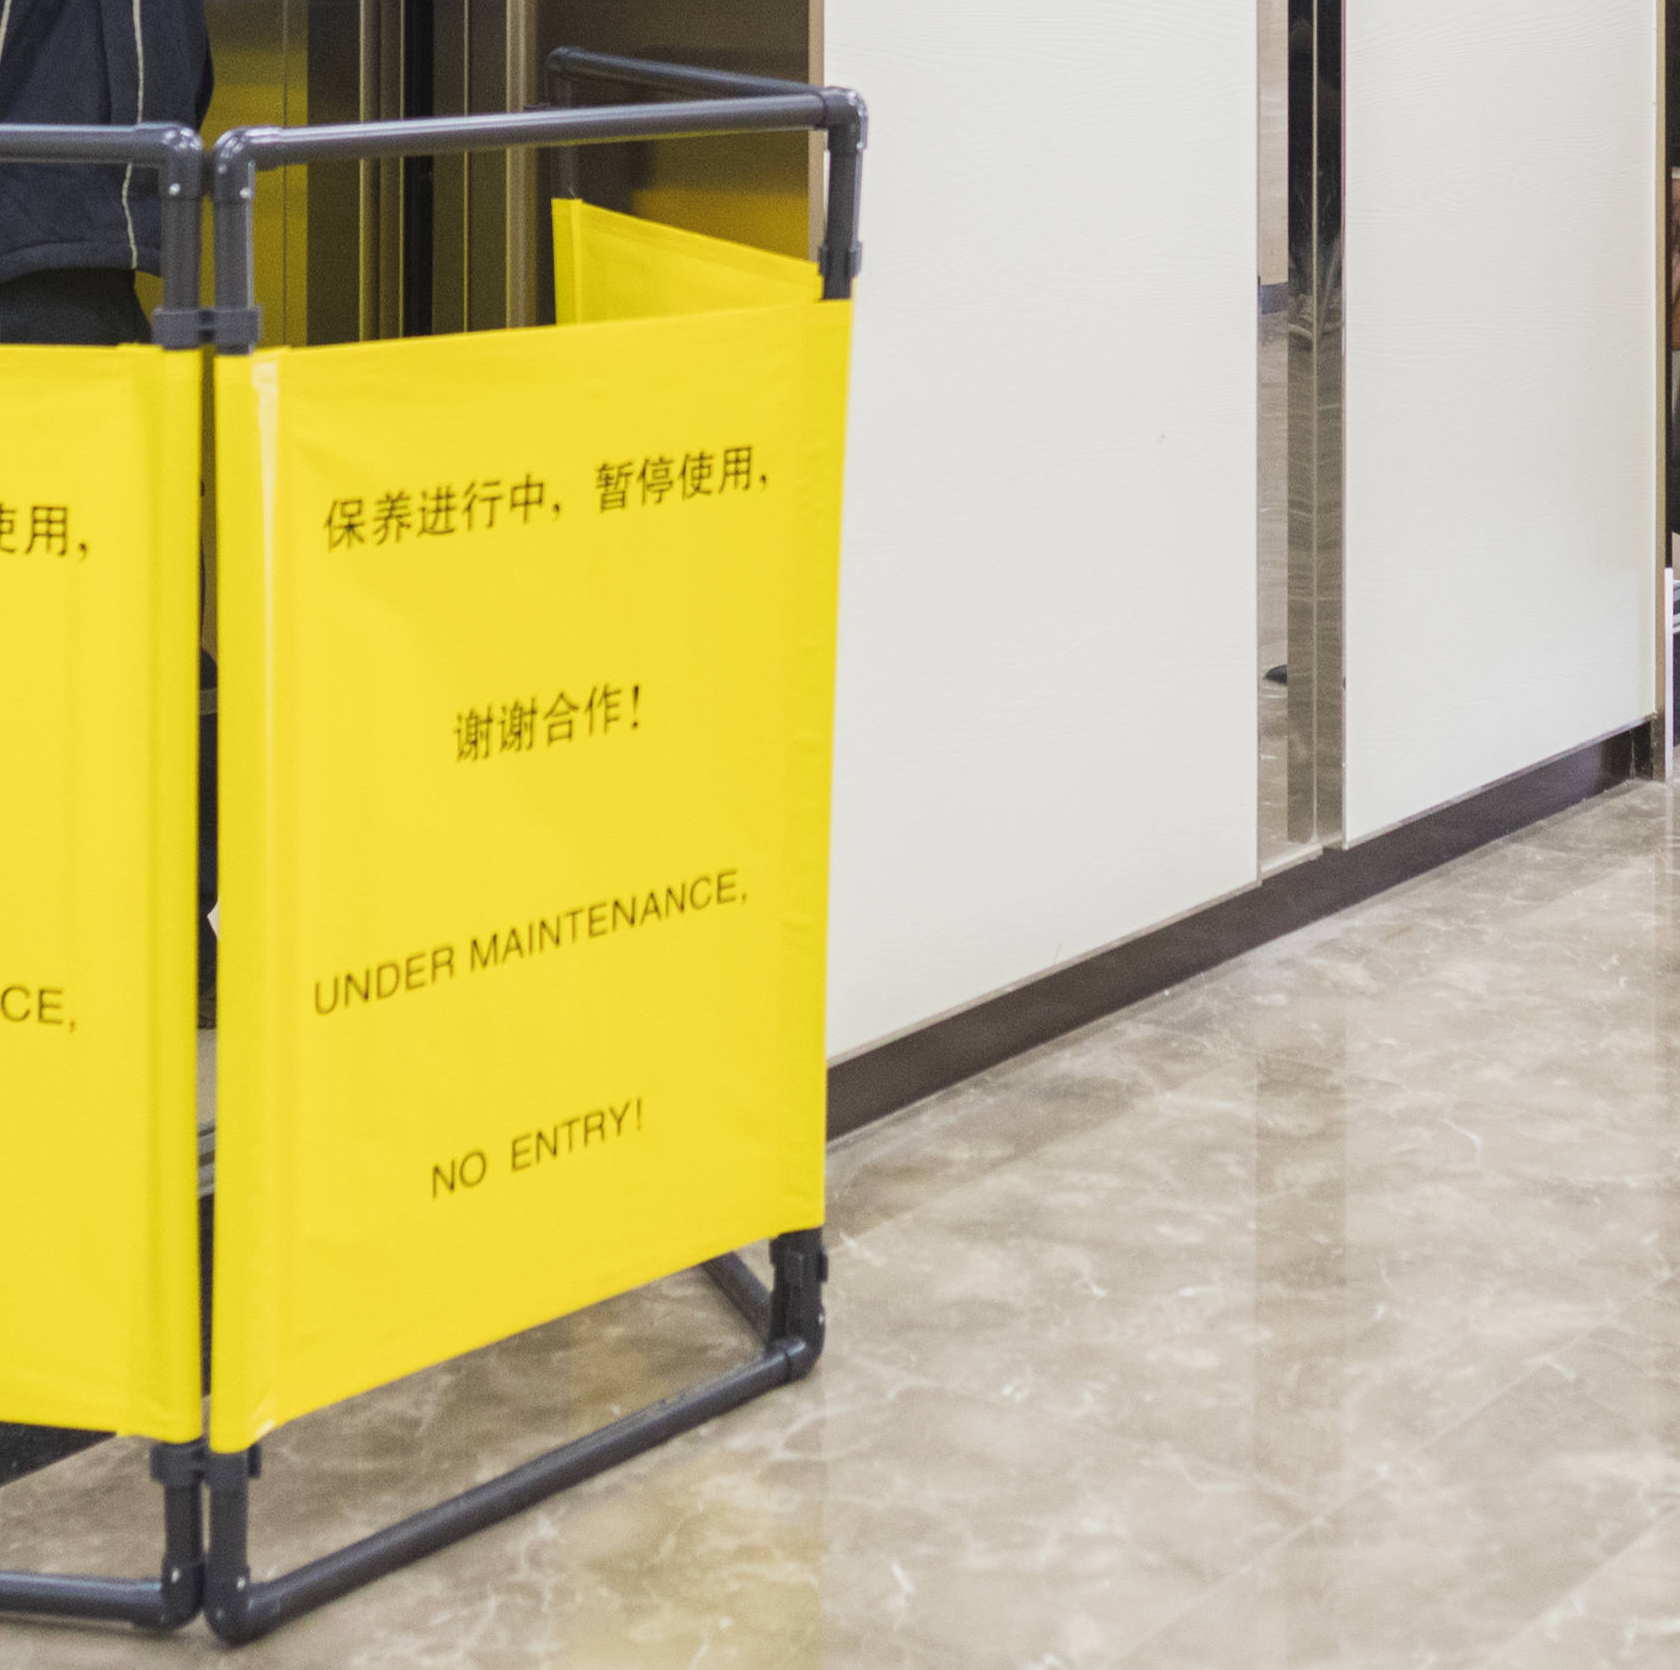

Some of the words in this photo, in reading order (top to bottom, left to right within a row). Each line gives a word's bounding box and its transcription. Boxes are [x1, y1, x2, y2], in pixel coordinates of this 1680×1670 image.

[314, 945, 455, 1016] UNDER
[469, 867, 747, 974] MAINTENANCE,
[432, 1150, 487, 1199] NO
[511, 1097, 642, 1172] ENTRY!
